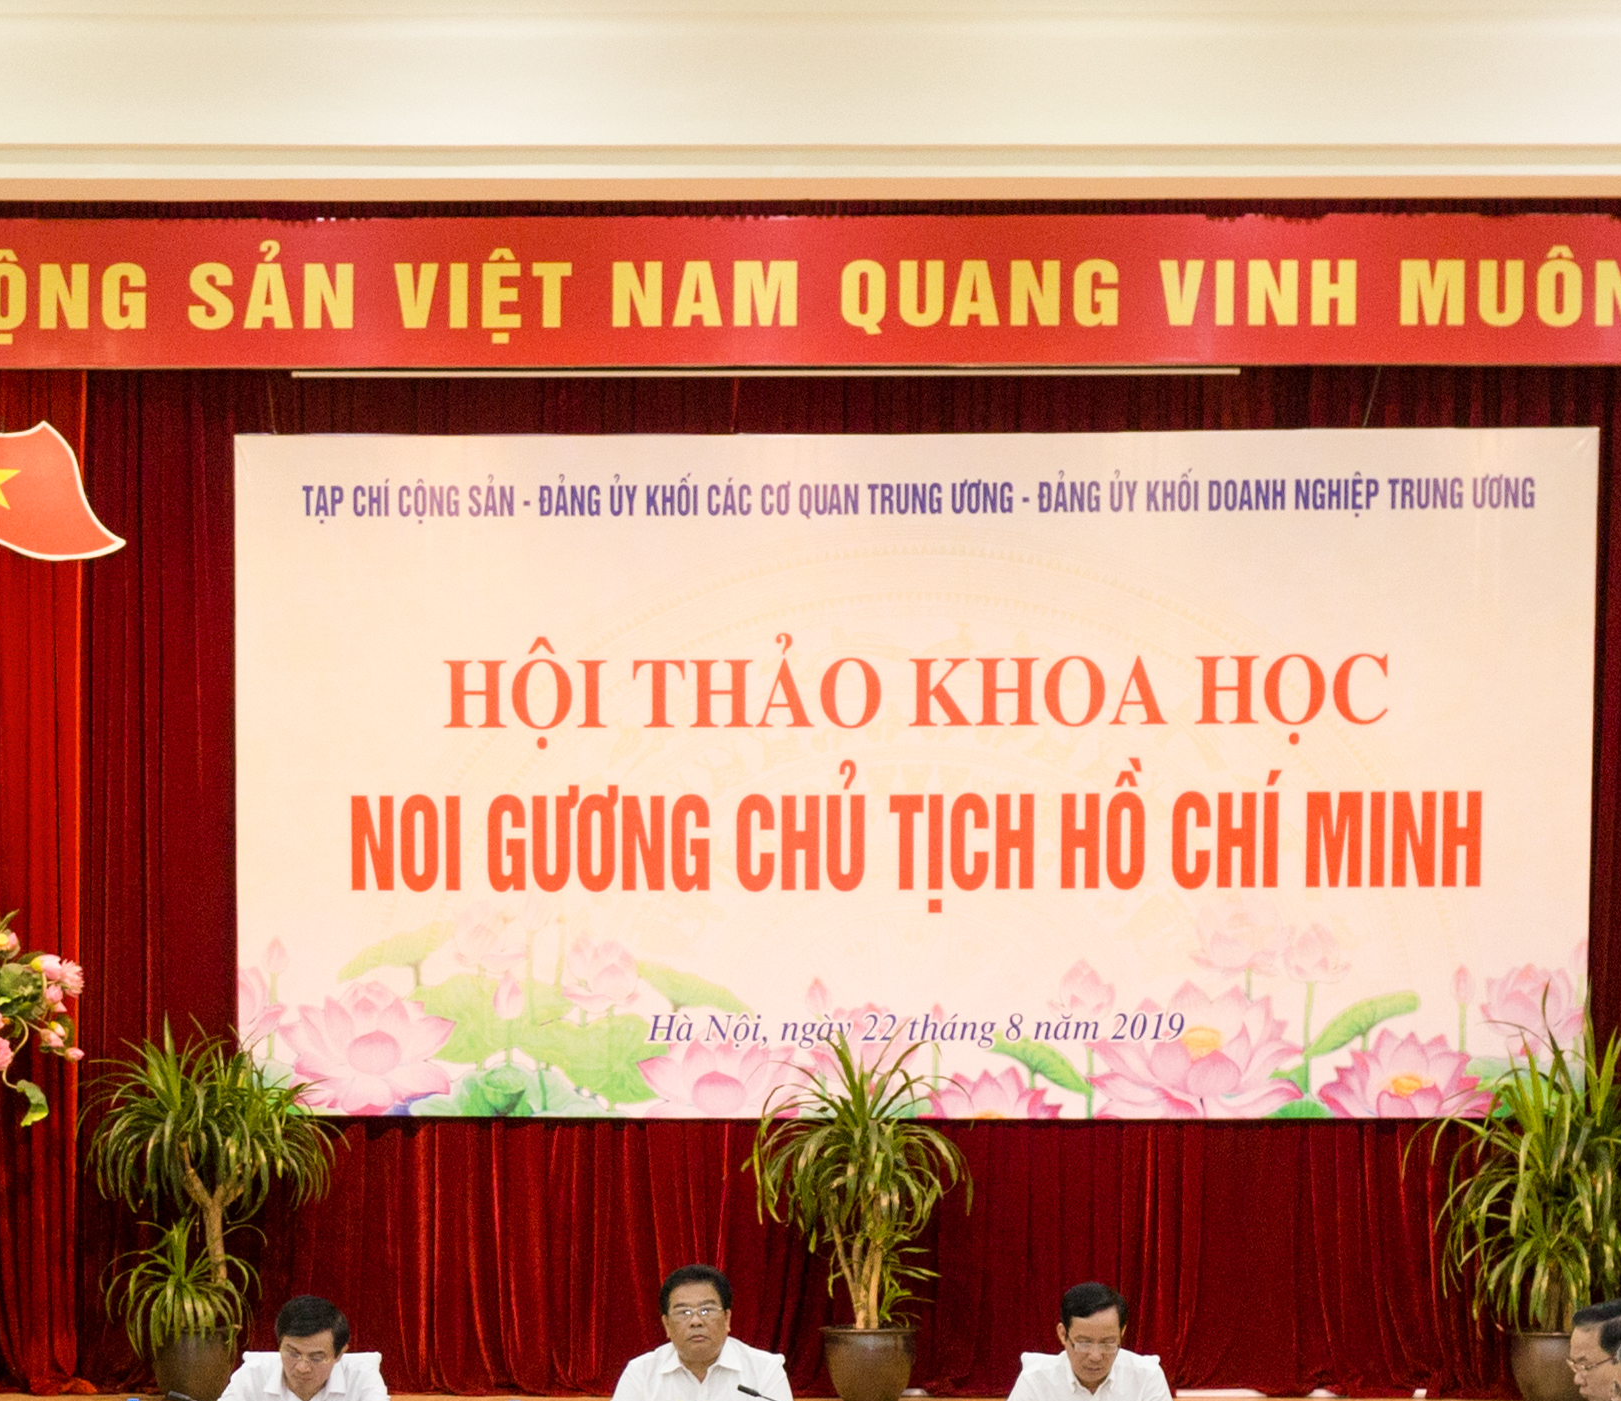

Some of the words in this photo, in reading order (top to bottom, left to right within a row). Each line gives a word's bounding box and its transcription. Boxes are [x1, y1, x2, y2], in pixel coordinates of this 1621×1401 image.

[189, 240, 353, 329] SẢN
[395, 249, 571, 343] VIỆT
[613, 261, 797, 327] NAM
[841, 259, 1118, 334] QUANG
[1160, 260, 1356, 326] VINH
[302, 485, 344, 524] TẠP
[352, 478, 390, 517] CHÍ
[398, 478, 460, 524] CỘNG
[468, 474, 515, 517] SẢN
[538, 473, 601, 517] ĐẢNG
[609, 473, 638, 517] ỦY
[646, 472, 699, 517] KHỐI
[707, 476, 752, 516] CÁC
[760, 481, 791, 516] CƠ
[800, 484, 858, 518] QUAN
[868, 483, 942, 514] TRUNG
[952, 479, 1013, 514] ƯƠNG
[1037, 470, 1101, 513] ĐẢNG
[1109, 470, 1138, 513] ỦY
[1146, 467, 1199, 513] KHỐI
[1209, 479, 1285, 511] DOANH
[1294, 472, 1380, 518] NGHIỆP
[1388, 478, 1463, 509] TRUNG
[1472, 474, 1535, 509] ƯƠNG
[445, 637, 605, 749] HỘI
[633, 633, 881, 728] THẢO
[910, 656, 1166, 726] KHOA
[1197, 654, 1387, 745] HỌC
[351, 794, 460, 892] NOI
[488, 785, 709, 892] GƯƠNG
[737, 760, 864, 891] CHỦ
[890, 793, 1034, 913] TỊCH
[1061, 756, 1145, 890] HỒ
[1172, 770, 1281, 889] CHÍ
[1306, 791, 1482, 887] MINH
[648, 1014, 693, 1042] Hà
[705, 1014, 768, 1048] Nội,
[780, 1014, 852, 1049] ngày
[862, 1014, 897, 1042] 22
[908, 1014, 996, 1049] tháng
[1005, 1013, 1024, 1041] 8
[1034, 1014, 1100, 1040] năm
[1111, 1013, 1185, 1041] 2019
